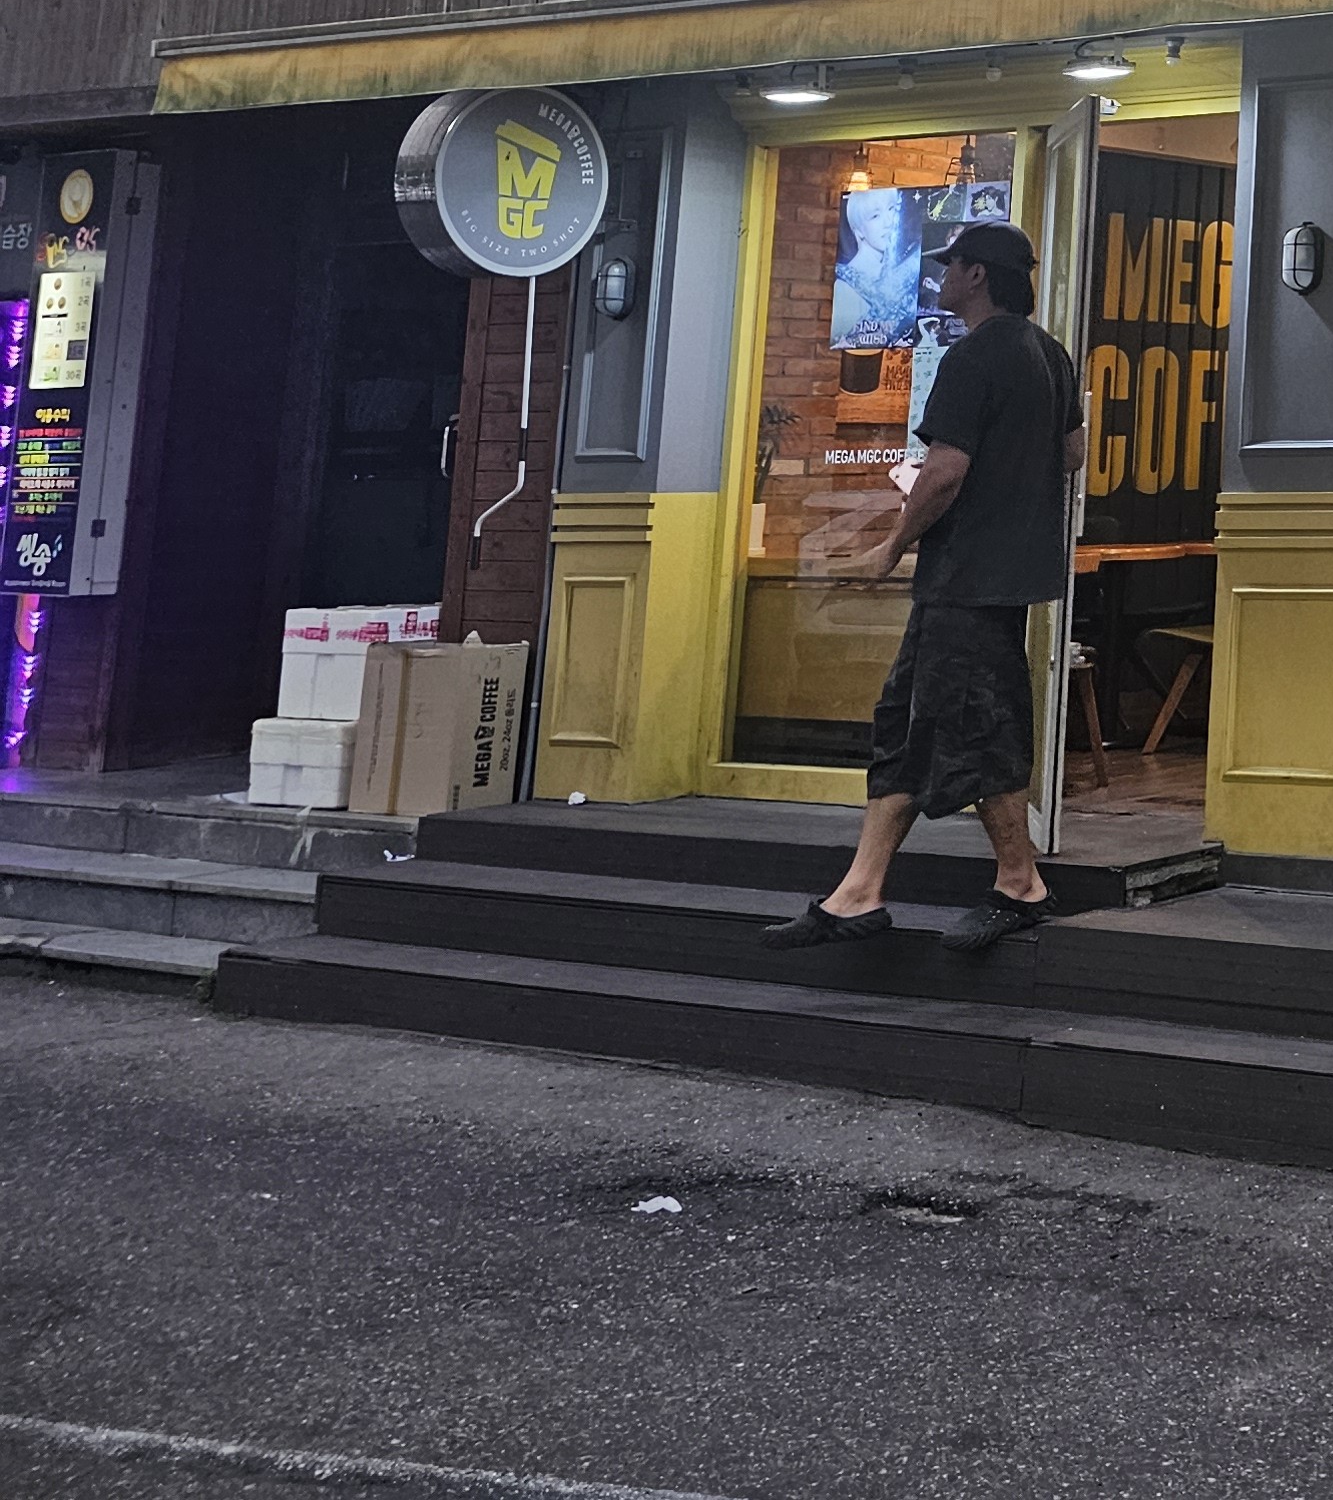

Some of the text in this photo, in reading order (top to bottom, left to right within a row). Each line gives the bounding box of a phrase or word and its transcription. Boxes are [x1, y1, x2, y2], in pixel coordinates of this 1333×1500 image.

[825, 449, 855, 465] MEGA
[856, 449, 881, 464] MGC
[1087, 345, 1228, 497] COF
[472, 677, 499, 788] MEGA COFFEE
